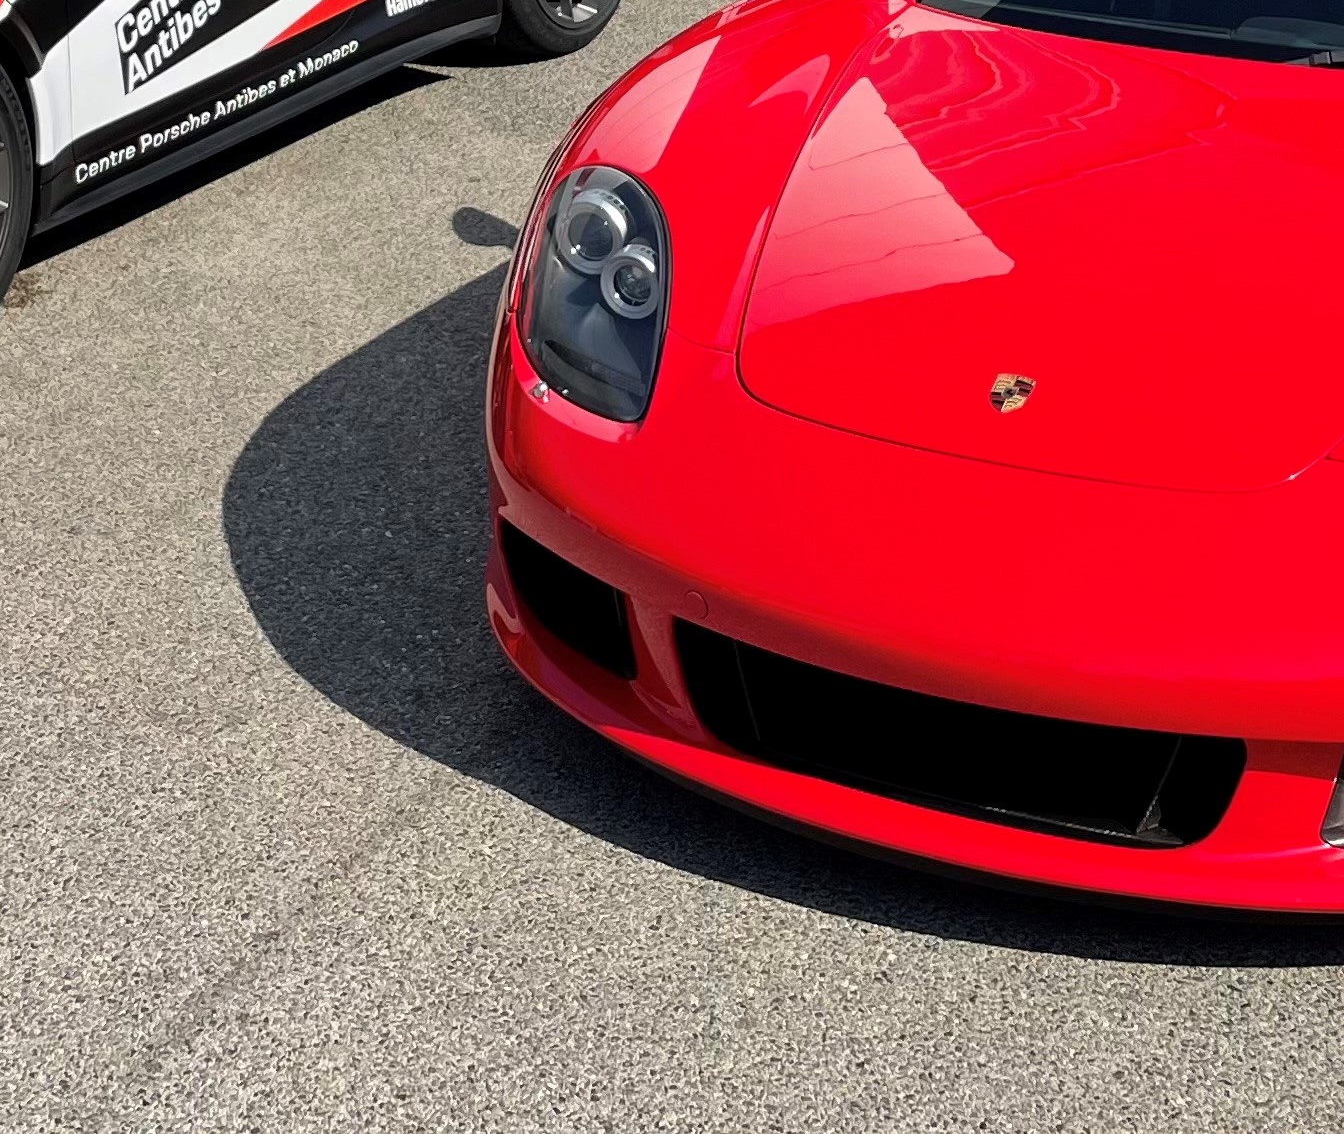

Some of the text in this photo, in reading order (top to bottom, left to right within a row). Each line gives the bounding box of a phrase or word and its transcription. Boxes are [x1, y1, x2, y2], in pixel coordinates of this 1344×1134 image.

[75, 39, 359, 184] Centre Porsche Antibes et Monaco
